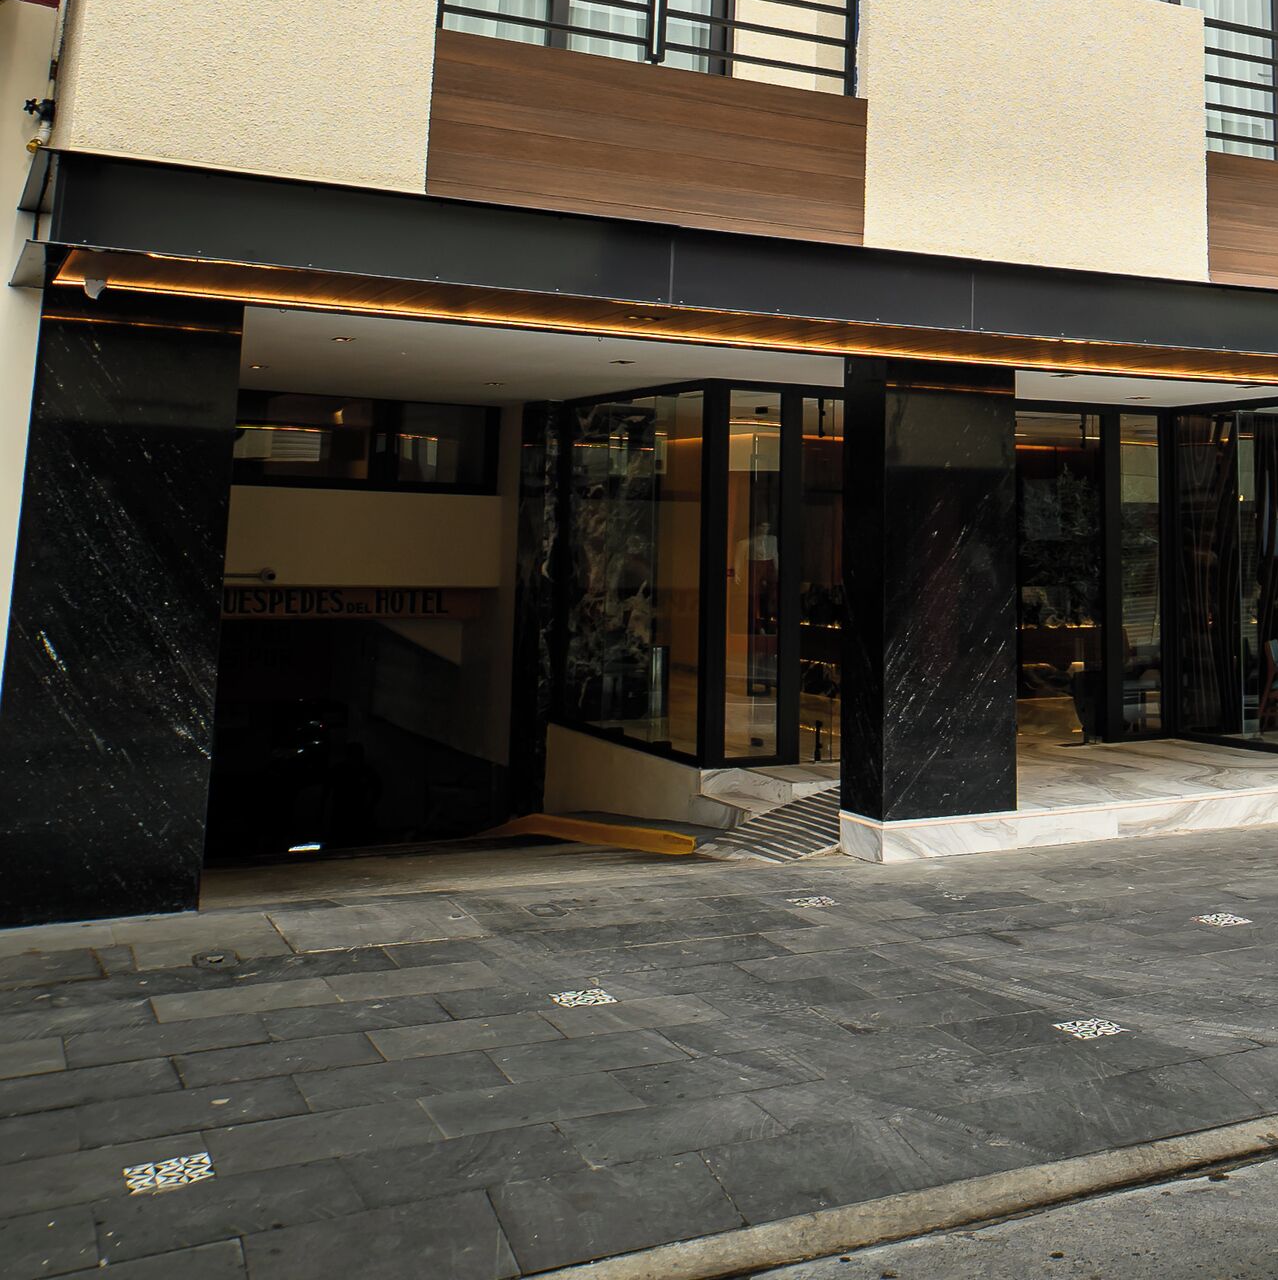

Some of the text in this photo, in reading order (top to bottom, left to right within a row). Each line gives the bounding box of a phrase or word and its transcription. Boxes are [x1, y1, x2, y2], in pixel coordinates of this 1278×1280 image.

[223, 589, 449, 614] UESPEDES DEL HOTEL
